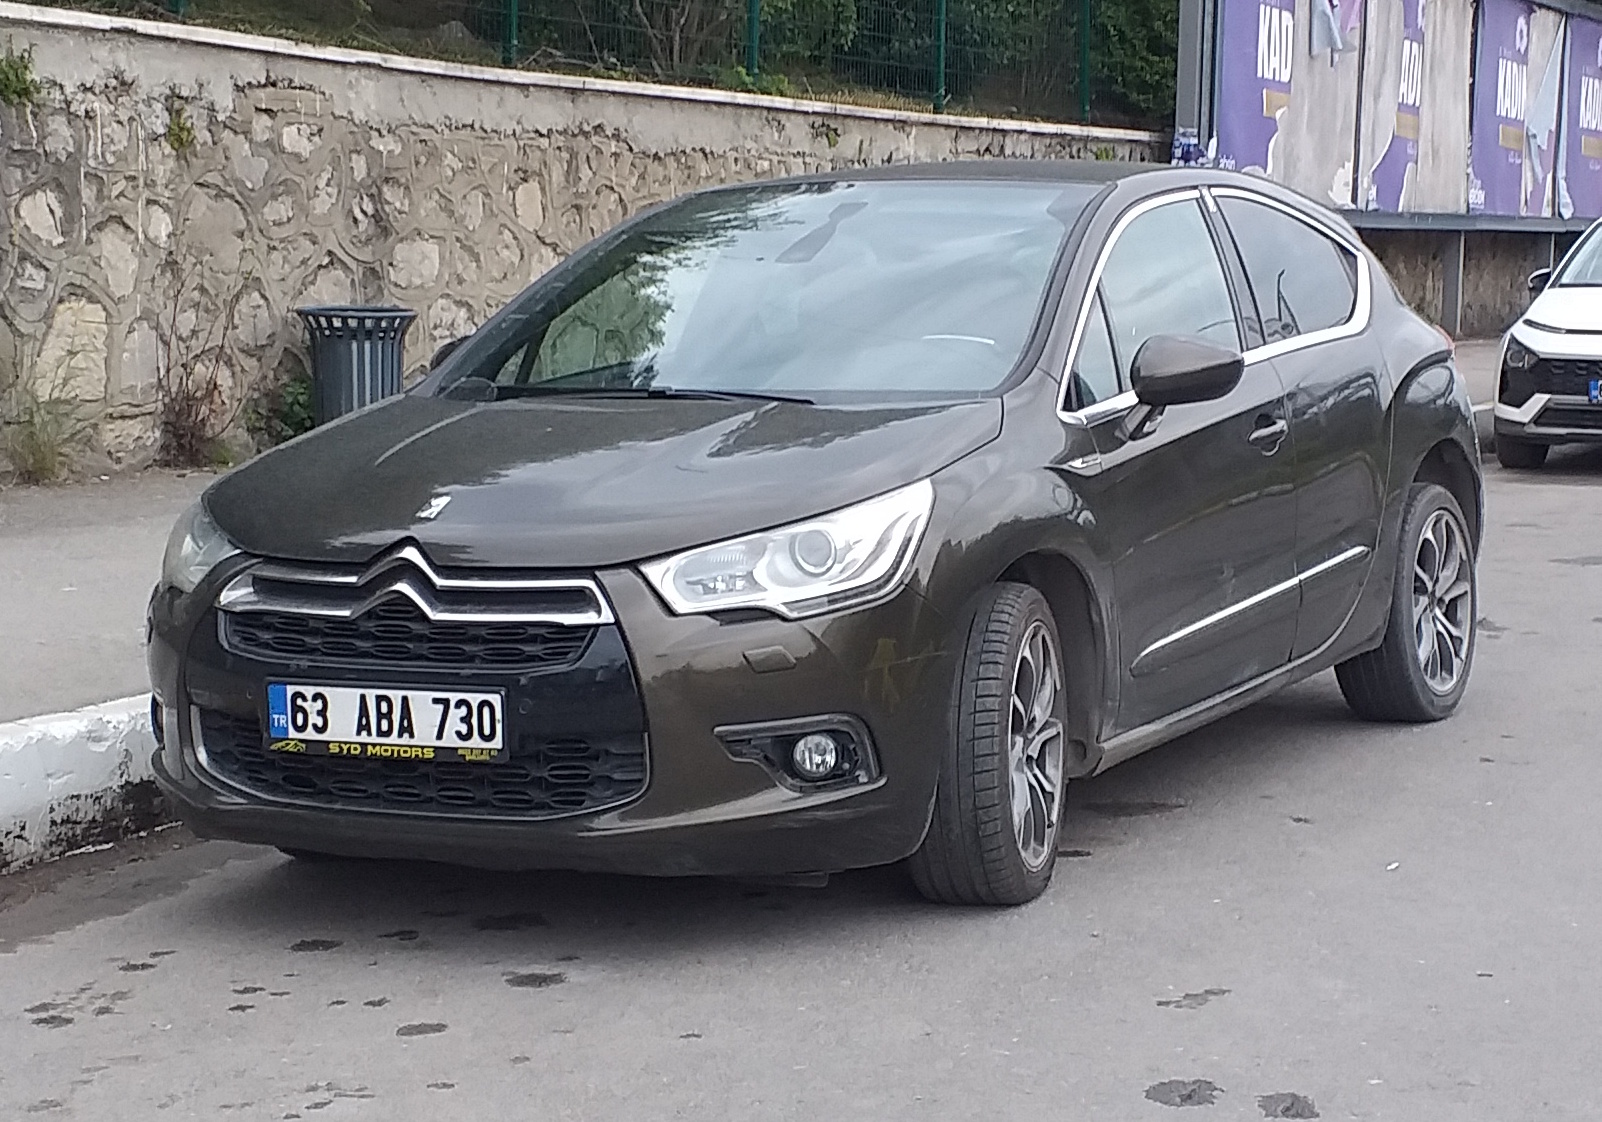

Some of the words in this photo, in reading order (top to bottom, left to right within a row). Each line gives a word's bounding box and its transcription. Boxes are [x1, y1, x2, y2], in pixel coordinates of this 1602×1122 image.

[273, 714, 287, 728] TR
[290, 691, 329, 735] 63
[355, 693, 415, 739] ABA
[432, 697, 497, 743] 730
[328, 742, 362, 755] SYD
[367, 745, 435, 759] MOTORS
